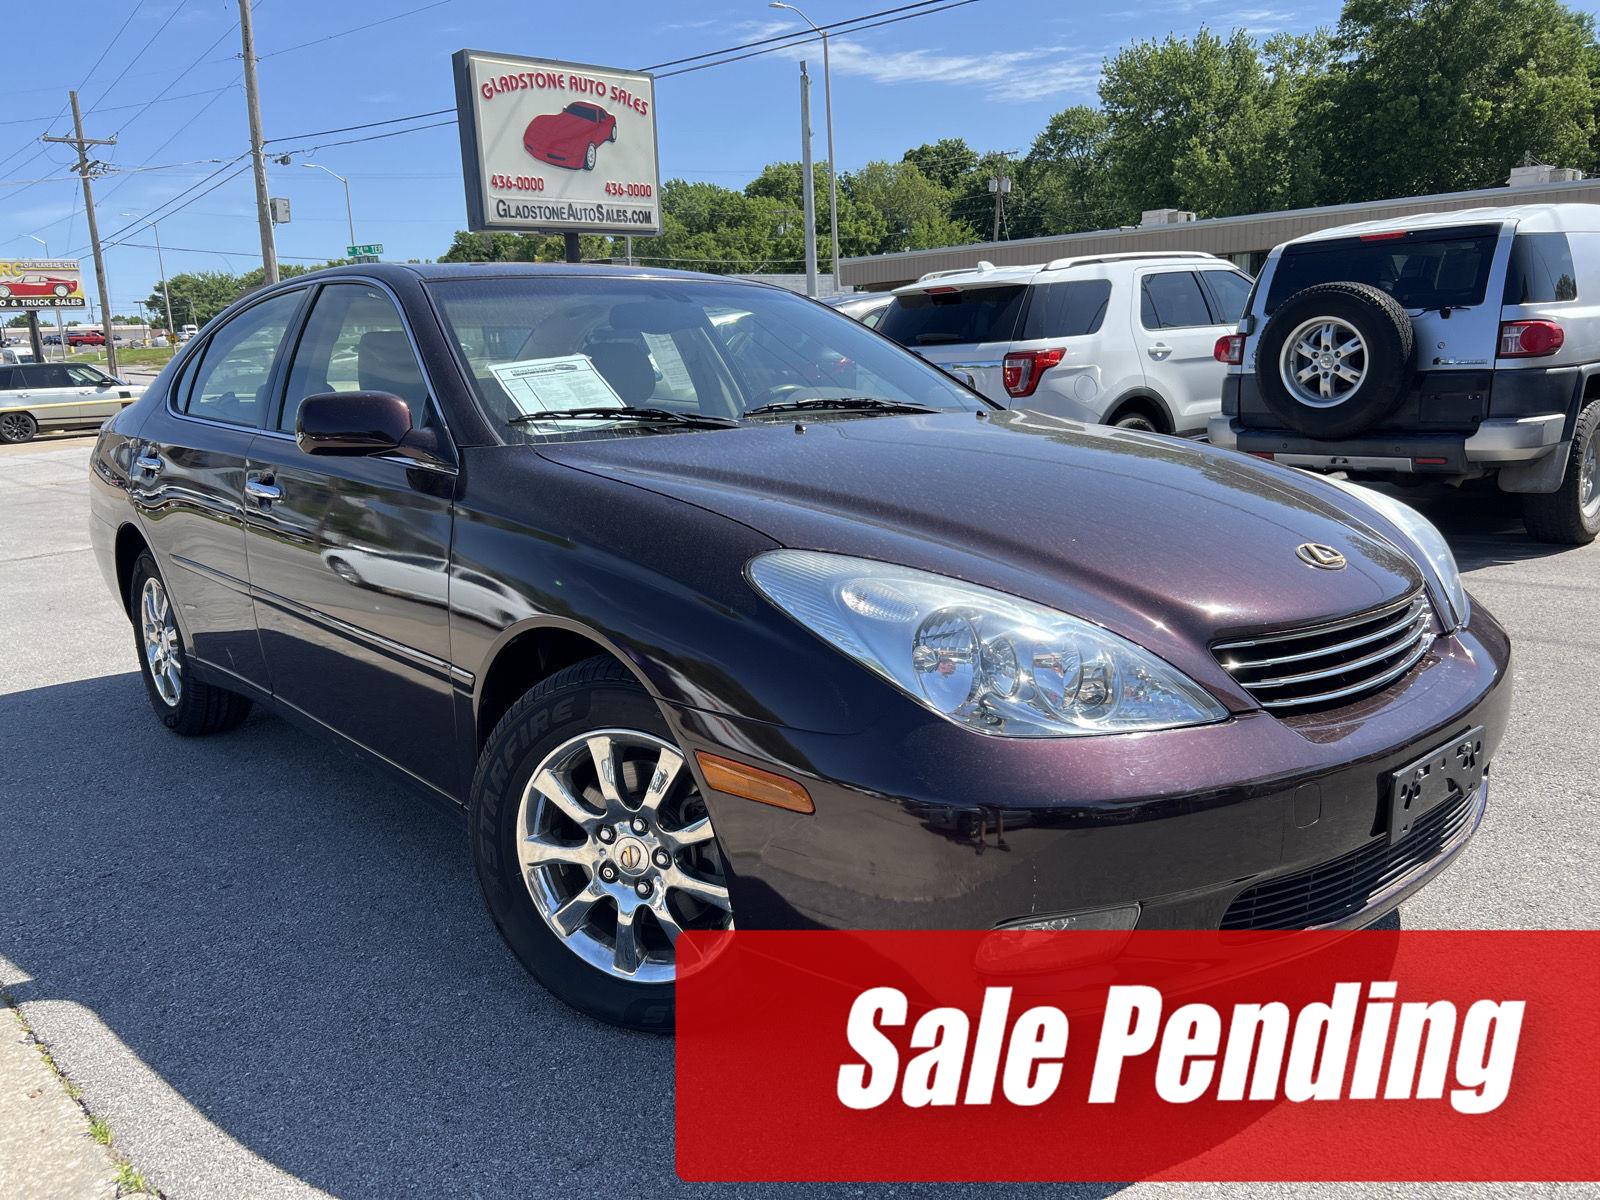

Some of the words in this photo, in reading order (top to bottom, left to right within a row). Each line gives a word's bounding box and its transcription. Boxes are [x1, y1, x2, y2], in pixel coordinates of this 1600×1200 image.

[481, 73, 565, 100] GLADSTONE
[569, 75, 607, 97] AUTO
[610, 86, 649, 115] SALES
[491, 174, 545, 192] 436-0000
[604, 181, 652, 197] 436-0000
[371, 245, 383, 253] TER
[479, 696, 576, 869] STARFIRE
